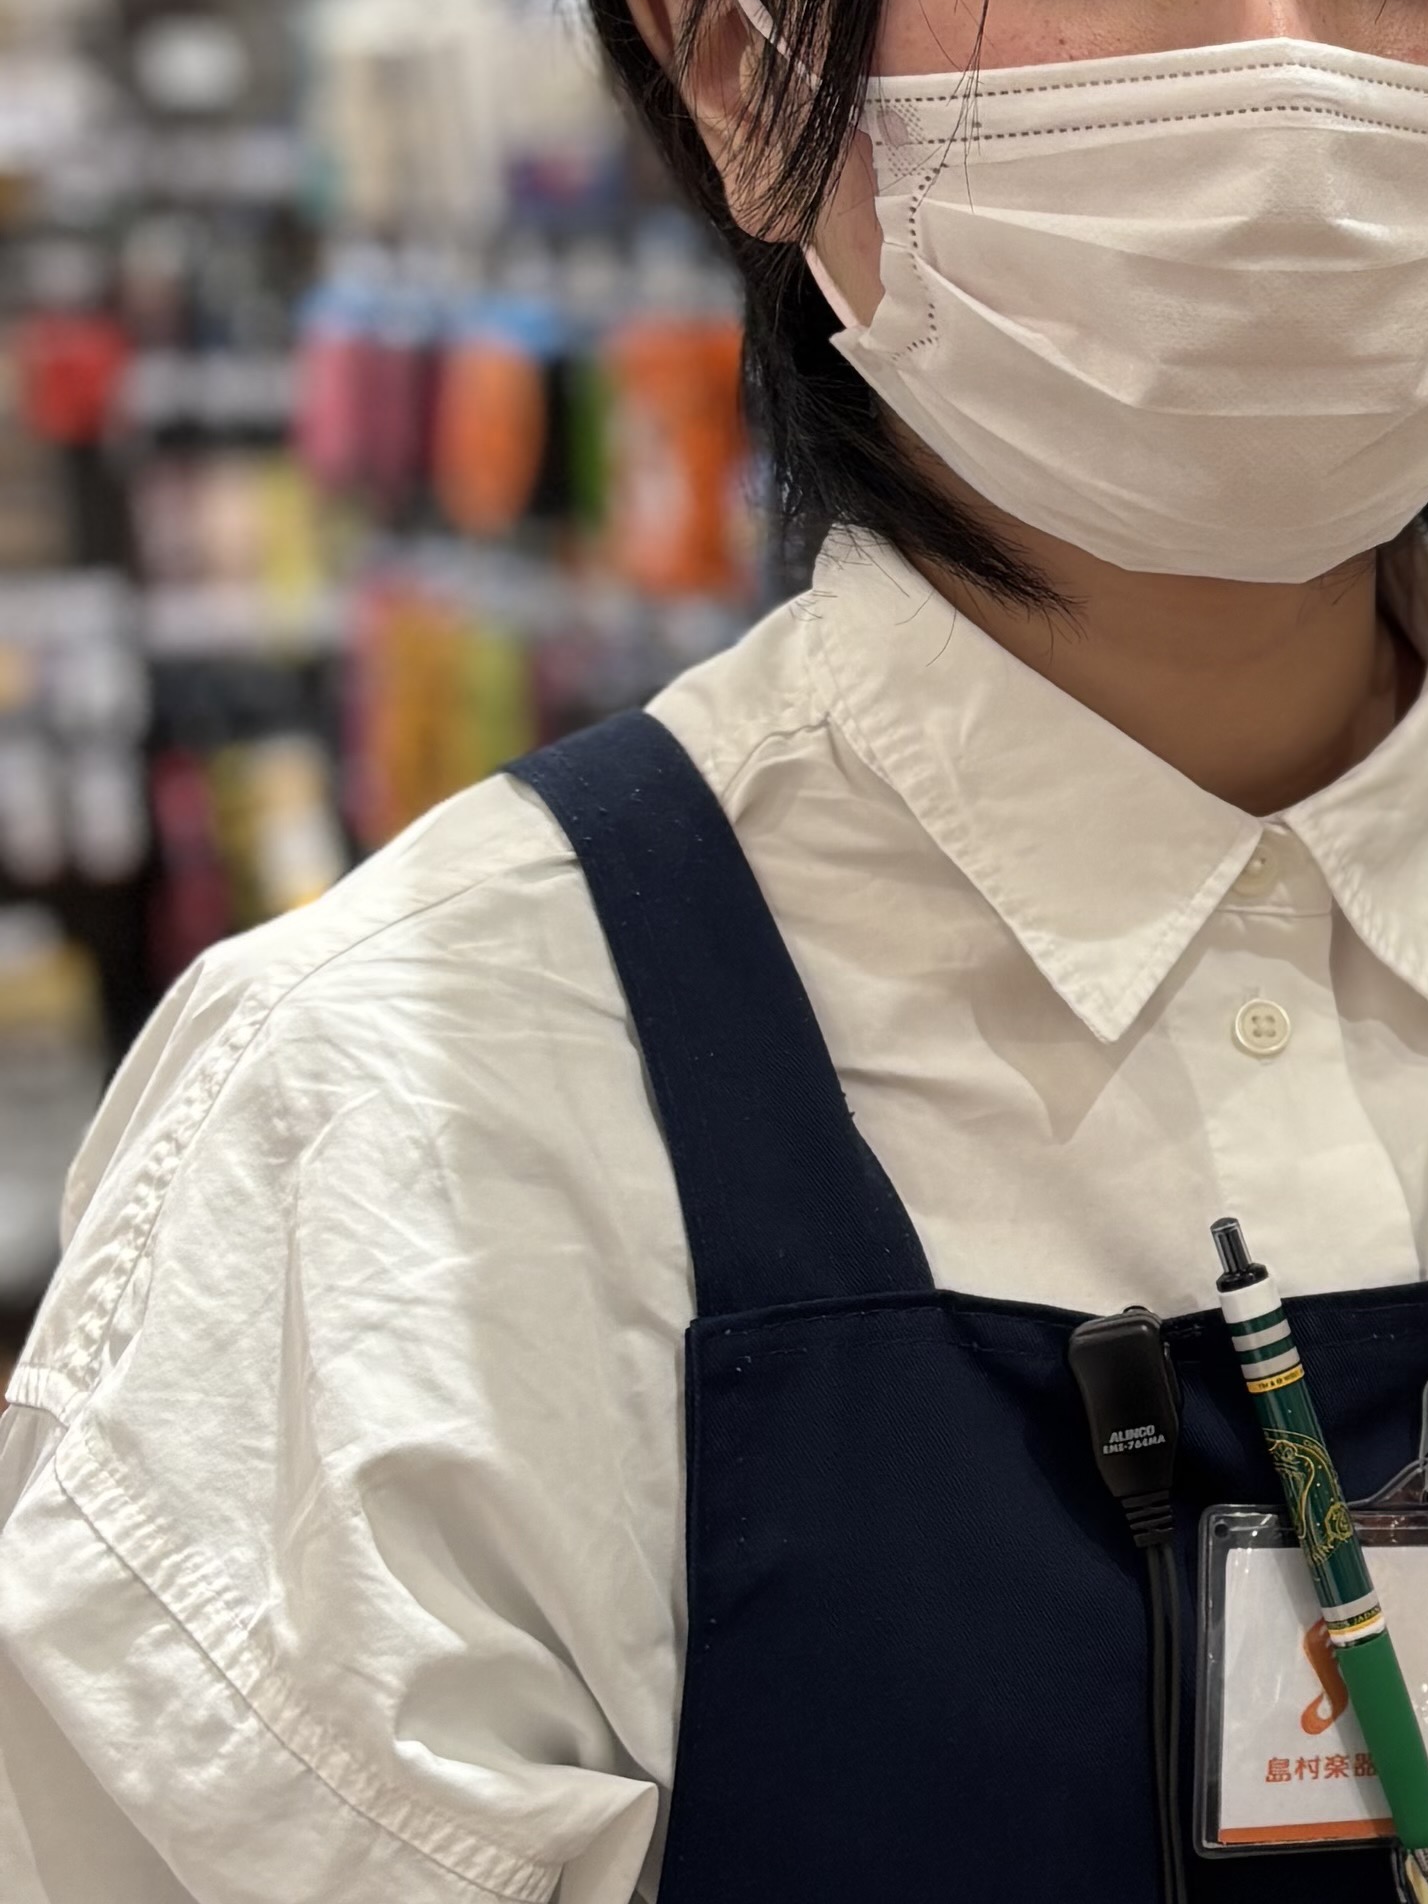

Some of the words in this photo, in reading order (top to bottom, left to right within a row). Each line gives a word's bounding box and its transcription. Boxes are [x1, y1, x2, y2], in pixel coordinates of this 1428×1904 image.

[1109, 1424, 1155, 1443] ALINCO
[1264, 1752, 1378, 1783] 島村楽器
